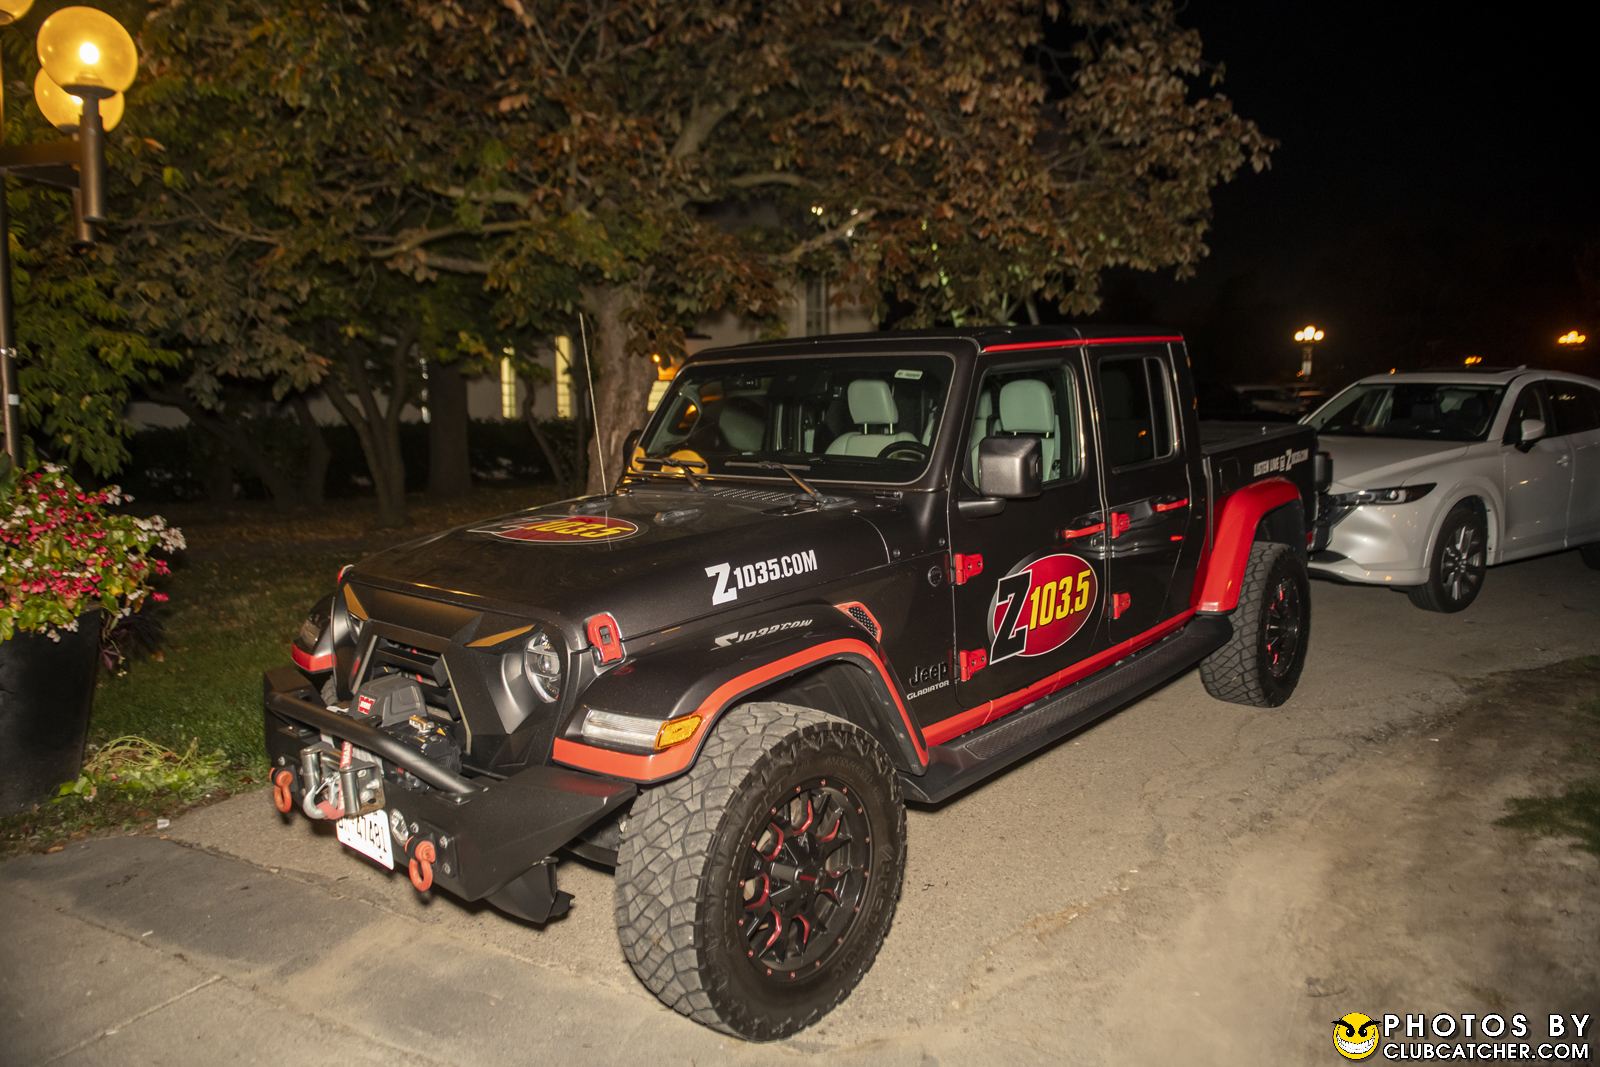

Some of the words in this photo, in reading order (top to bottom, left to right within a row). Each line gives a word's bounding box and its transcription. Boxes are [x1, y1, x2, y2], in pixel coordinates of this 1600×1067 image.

[704, 549, 818, 606] Z1035.COM
[909, 661, 948, 688] Jeep
[906, 680, 950, 701] GLADIATOR
